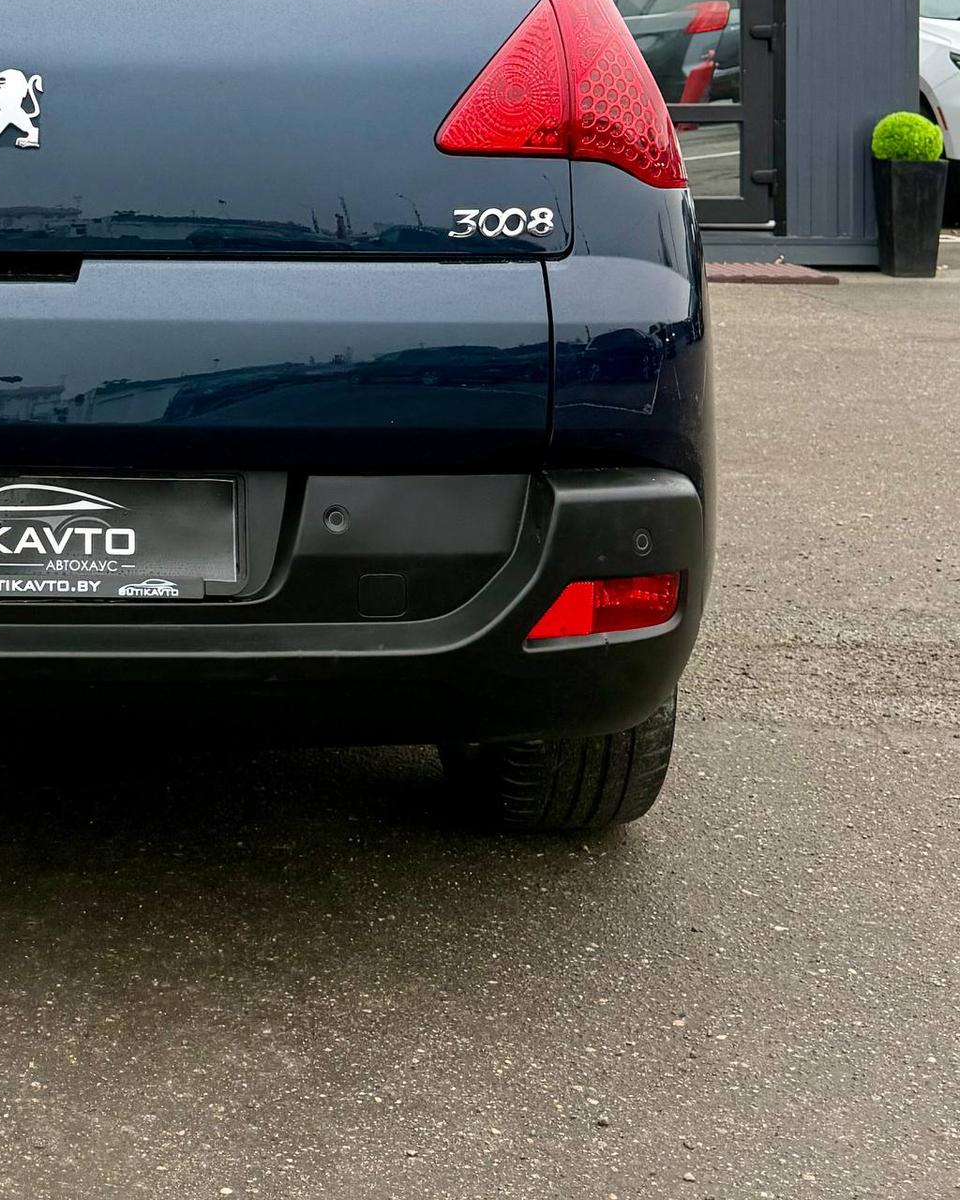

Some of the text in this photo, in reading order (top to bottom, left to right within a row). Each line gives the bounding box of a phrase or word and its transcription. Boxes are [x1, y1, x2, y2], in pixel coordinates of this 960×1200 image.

[448, 207, 554, 238] 3008
[45, 559, 118, 572] АВТОХАУС
[118, 587, 179, 596] BUTIKAVTO
